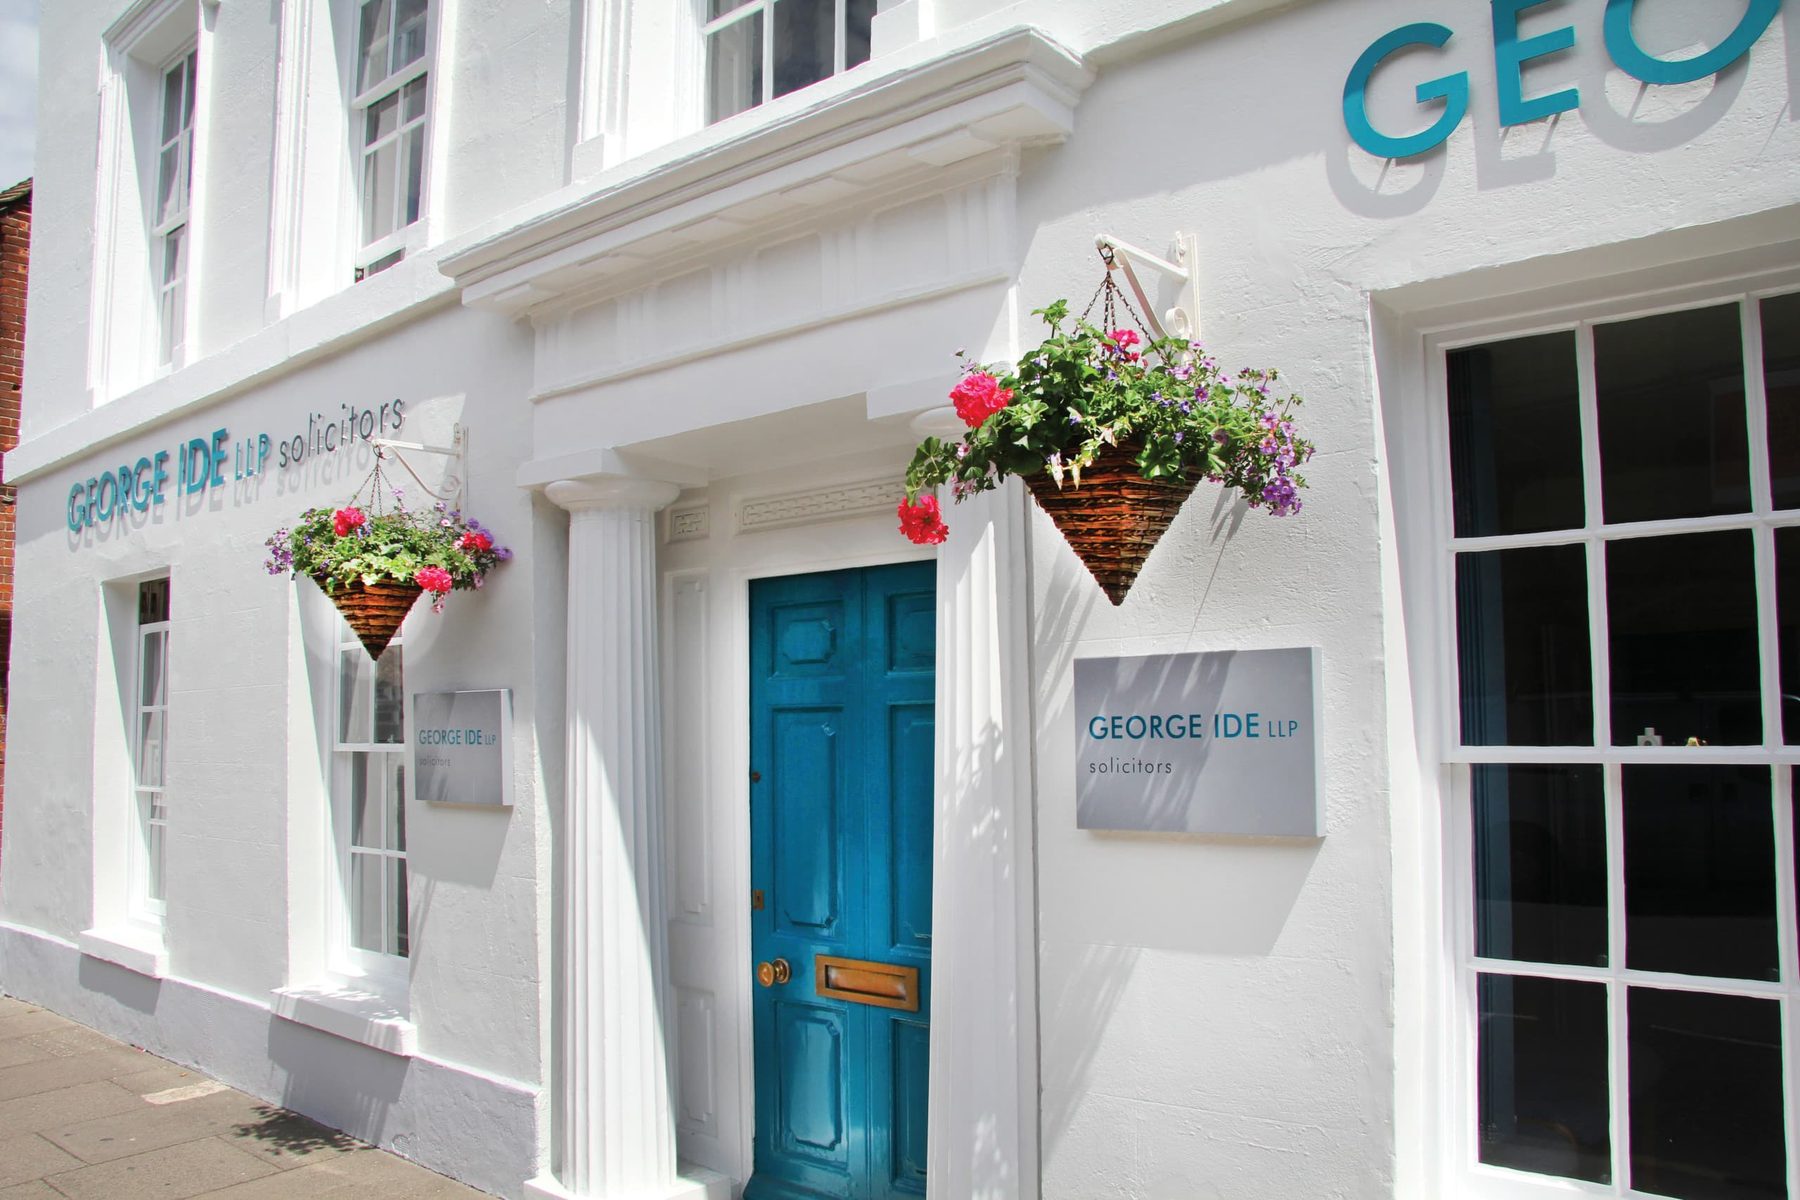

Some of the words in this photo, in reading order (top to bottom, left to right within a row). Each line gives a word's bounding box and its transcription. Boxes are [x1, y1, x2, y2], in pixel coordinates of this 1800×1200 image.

[67, 450, 168, 532] GEORGE
[178, 428, 227, 497] IDE
[235, 433, 270, 481] LLP
[279, 398, 404, 468] solicitors
[419, 729, 461, 744] GEORGE
[465, 729, 482, 745] IDE
[485, 734, 496, 745] LLP
[1089, 714, 1202, 740] GEORGE
[1214, 713, 1260, 738] IDE
[1268, 720, 1298, 738] LLP
[1089, 757, 1172, 774] solicitors
